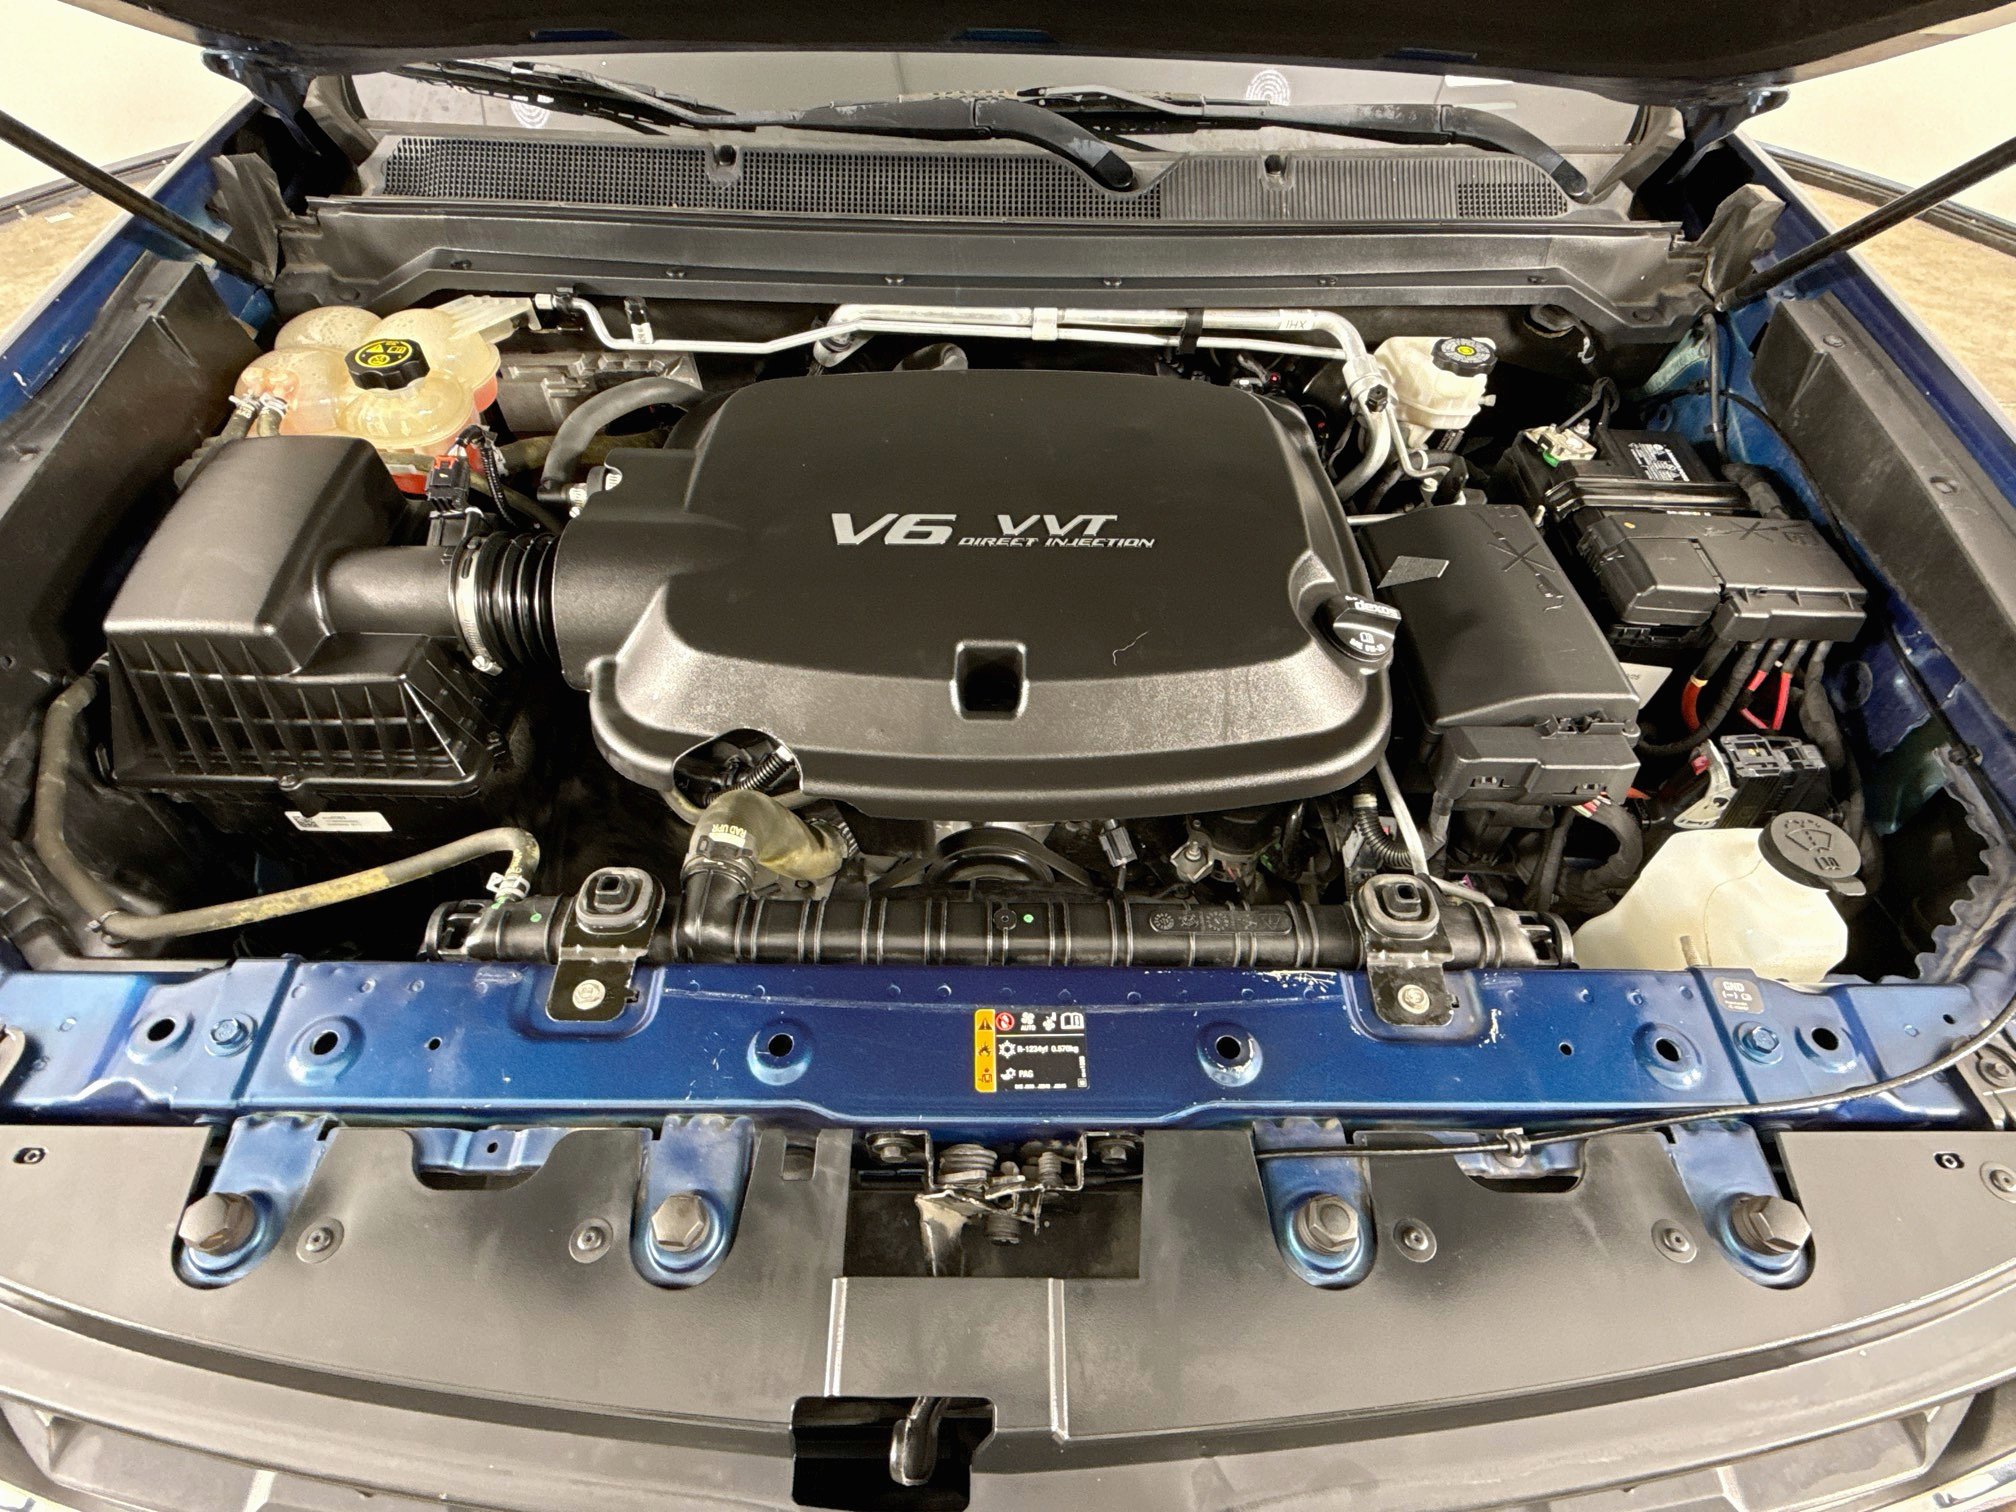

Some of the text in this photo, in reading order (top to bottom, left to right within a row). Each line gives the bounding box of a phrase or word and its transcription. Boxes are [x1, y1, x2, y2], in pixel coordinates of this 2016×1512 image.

[831, 512, 958, 546] V6
[997, 513, 1119, 537] VVT
[957, 536, 1156, 549] DIRECT INJECTION
[711, 823, 747, 838] RAD UPR
[1722, 981, 1745, 992] GND
